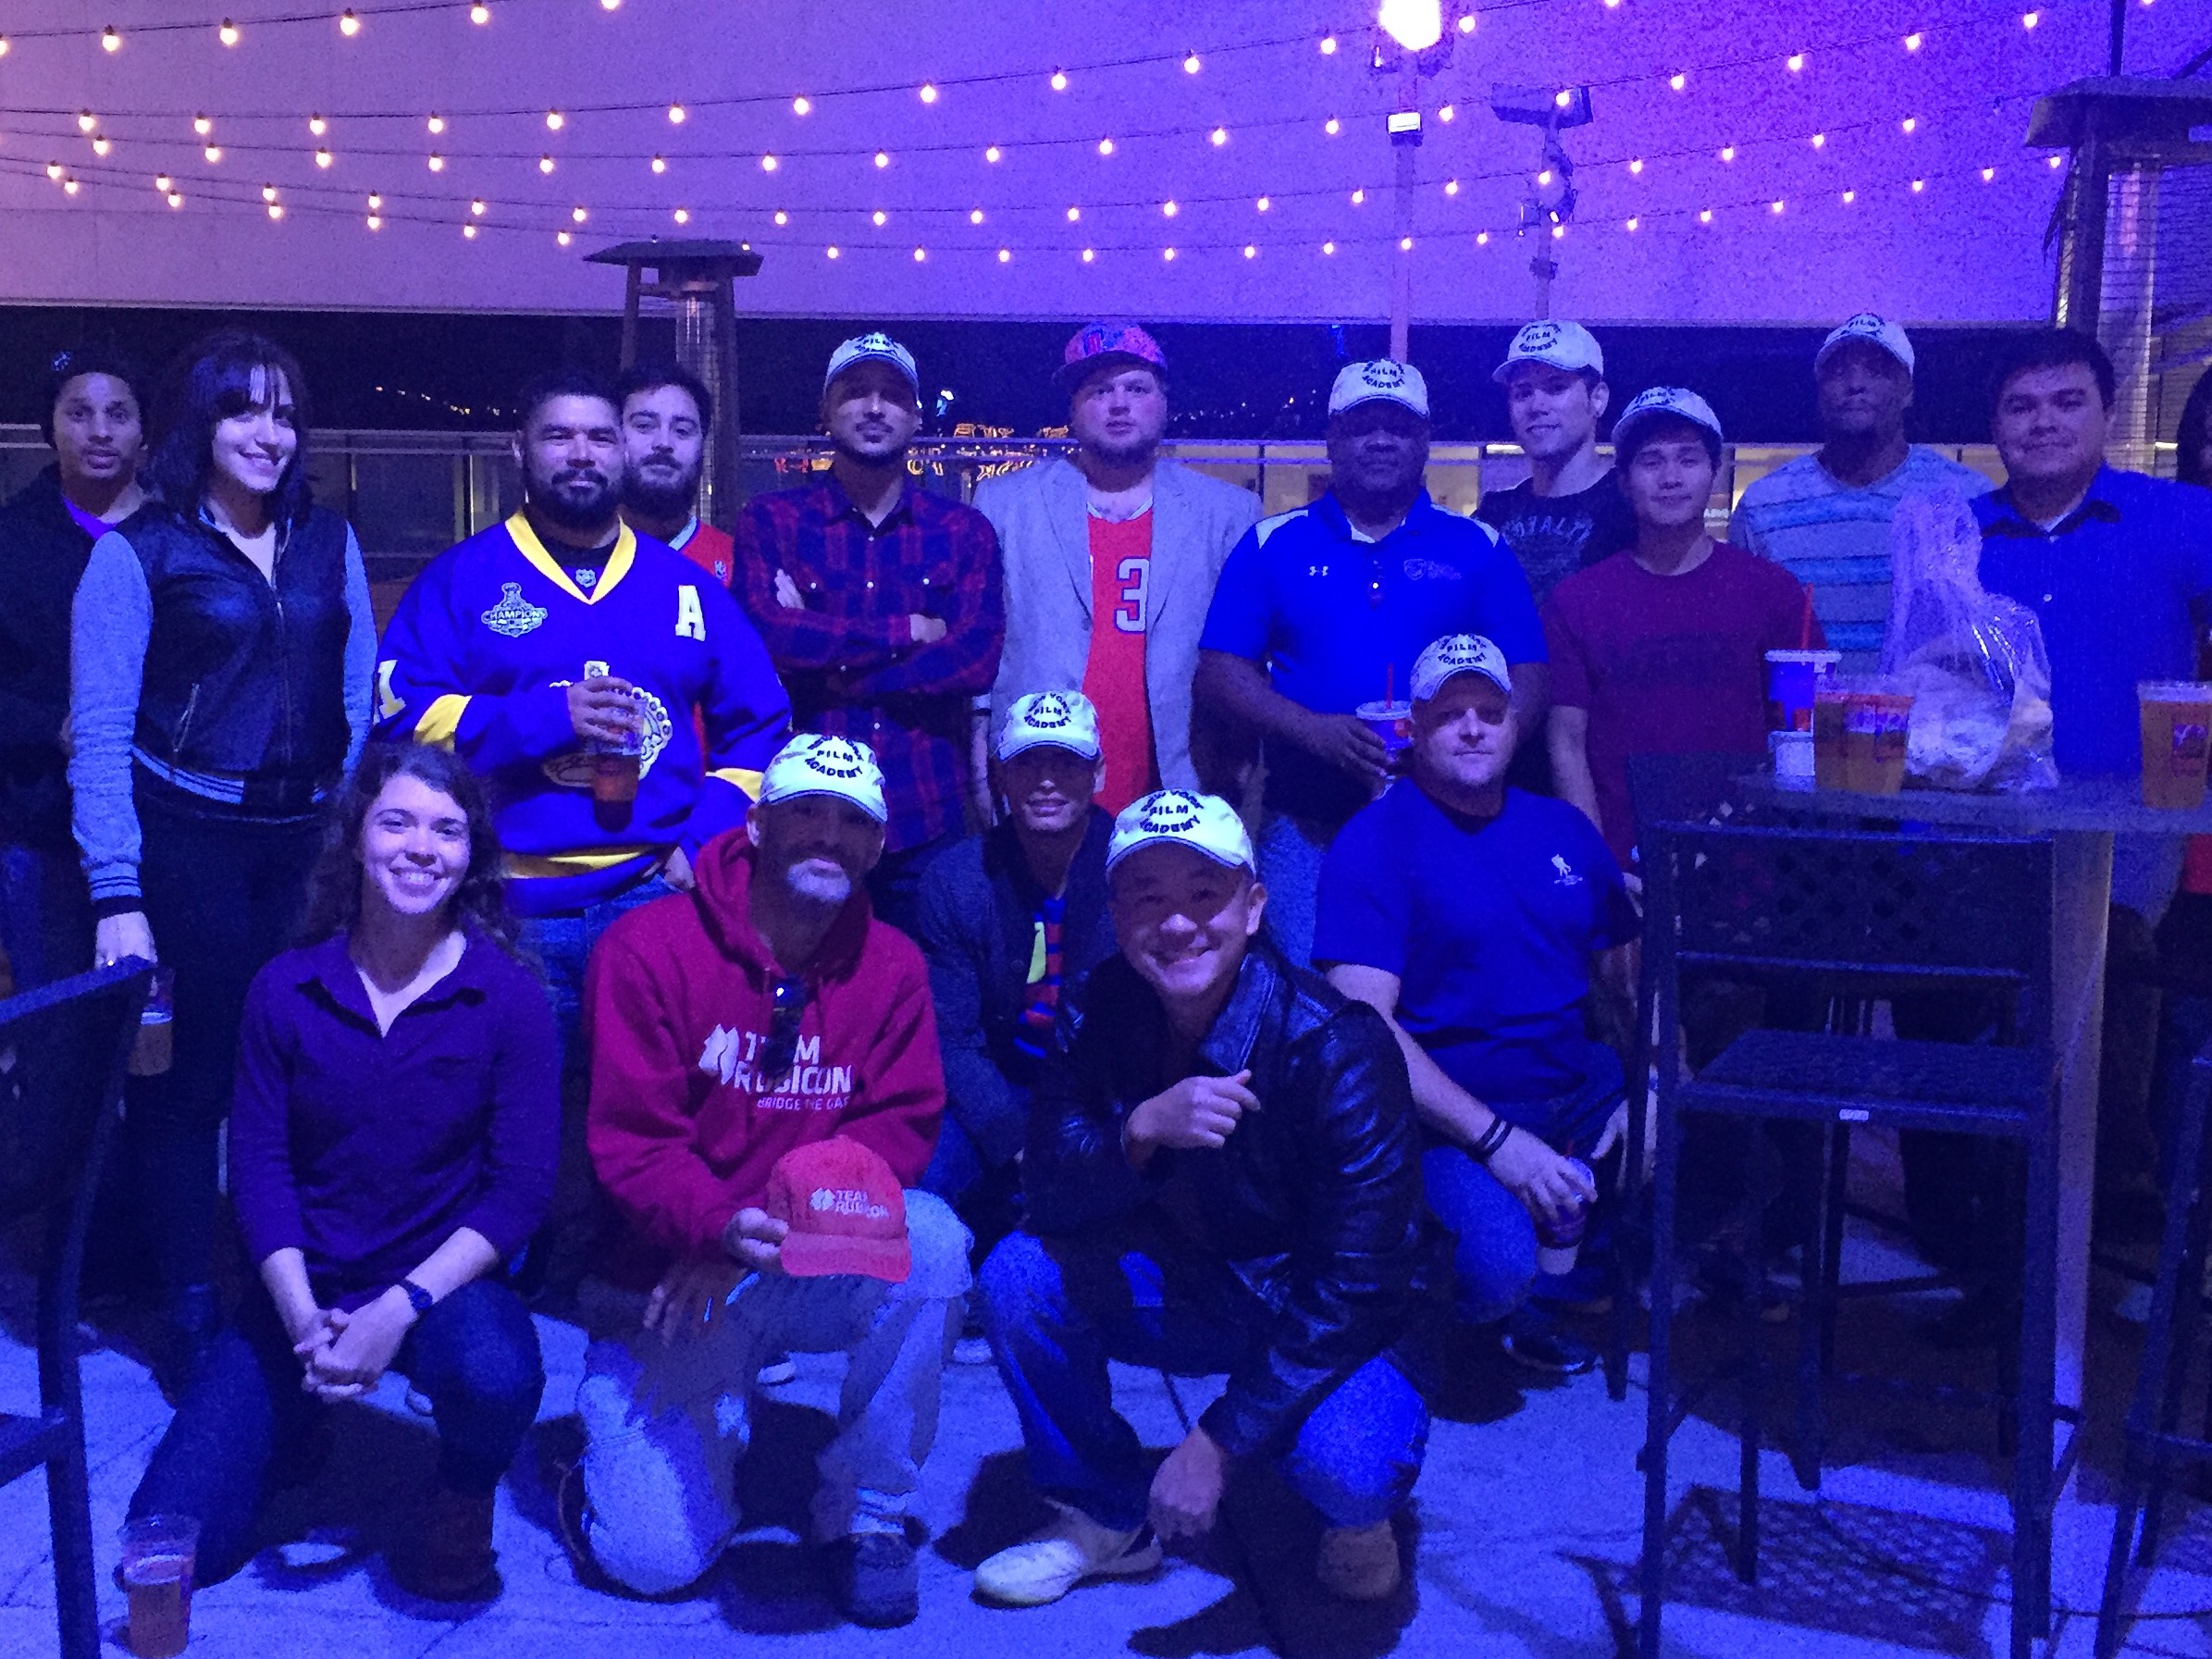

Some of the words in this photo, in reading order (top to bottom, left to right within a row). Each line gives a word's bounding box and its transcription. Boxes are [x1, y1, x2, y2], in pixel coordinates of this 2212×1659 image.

[1526, 331, 1551, 341] FILM
[674, 584, 707, 642] A
[1446, 643, 1477, 652] FILM
[1437, 652, 1488, 665] ACADEMY
[372, 659, 407, 725] 1
[1033, 706, 1063, 716] FILM
[1023, 714, 1072, 728] ACADEMY
[817, 749, 853, 762] FILM
[804, 757, 863, 778] ACADEMY
[1149, 804, 1189, 816] FILM
[1139, 814, 1201, 834] ACADEMY
[745, 1031, 821, 1065] TM
[834, 1202, 889, 1219] RUBON
